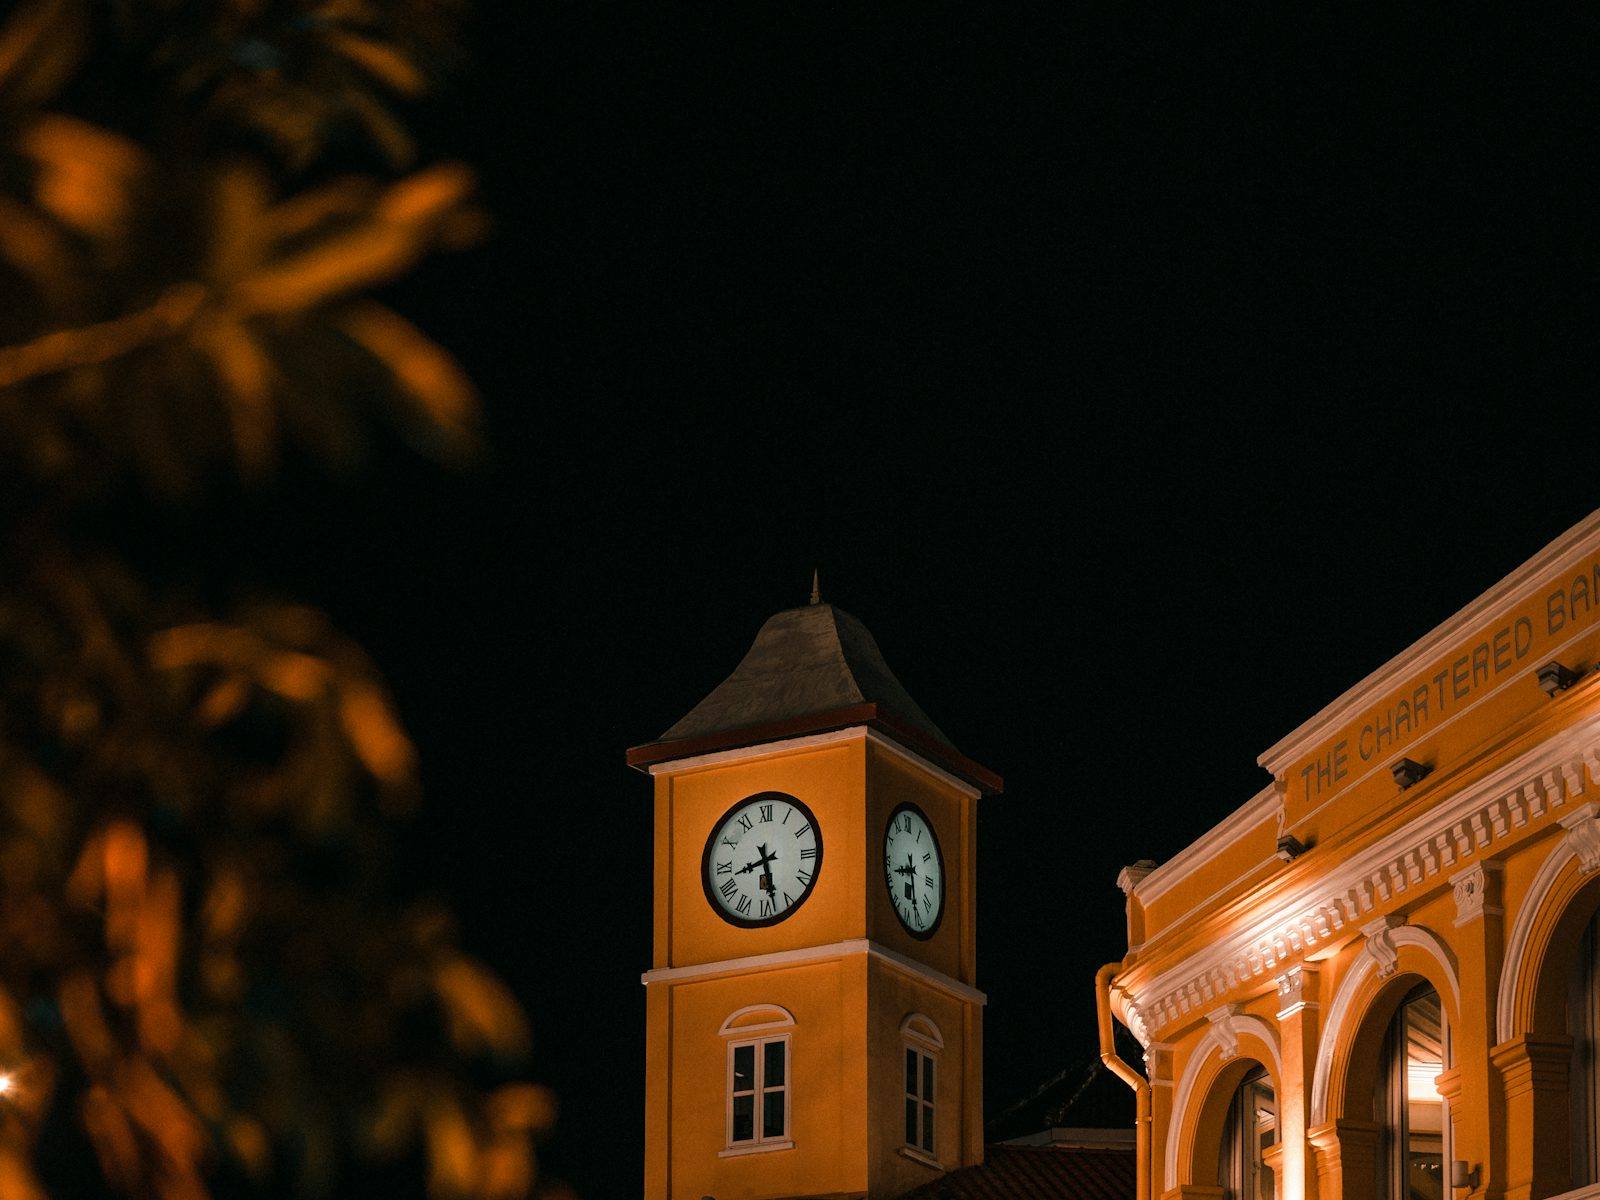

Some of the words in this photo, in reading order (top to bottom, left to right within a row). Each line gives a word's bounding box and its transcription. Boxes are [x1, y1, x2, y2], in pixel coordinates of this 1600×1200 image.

[1301, 739, 1349, 802] THE
[1358, 616, 1533, 761] CHARTERED
[759, 804, 775, 823] XII
[782, 808, 793, 824] I
[737, 813, 754, 833] XI
[794, 823, 811, 839] II
[722, 836, 738, 850] X
[800, 849, 816, 860] III
[717, 861, 732, 875] IX
[796, 869, 811, 887] IV
[720, 877, 738, 902] VIII
[783, 891, 795, 906] V
[735, 894, 752, 916] VII
[760, 899, 773, 917] VI
